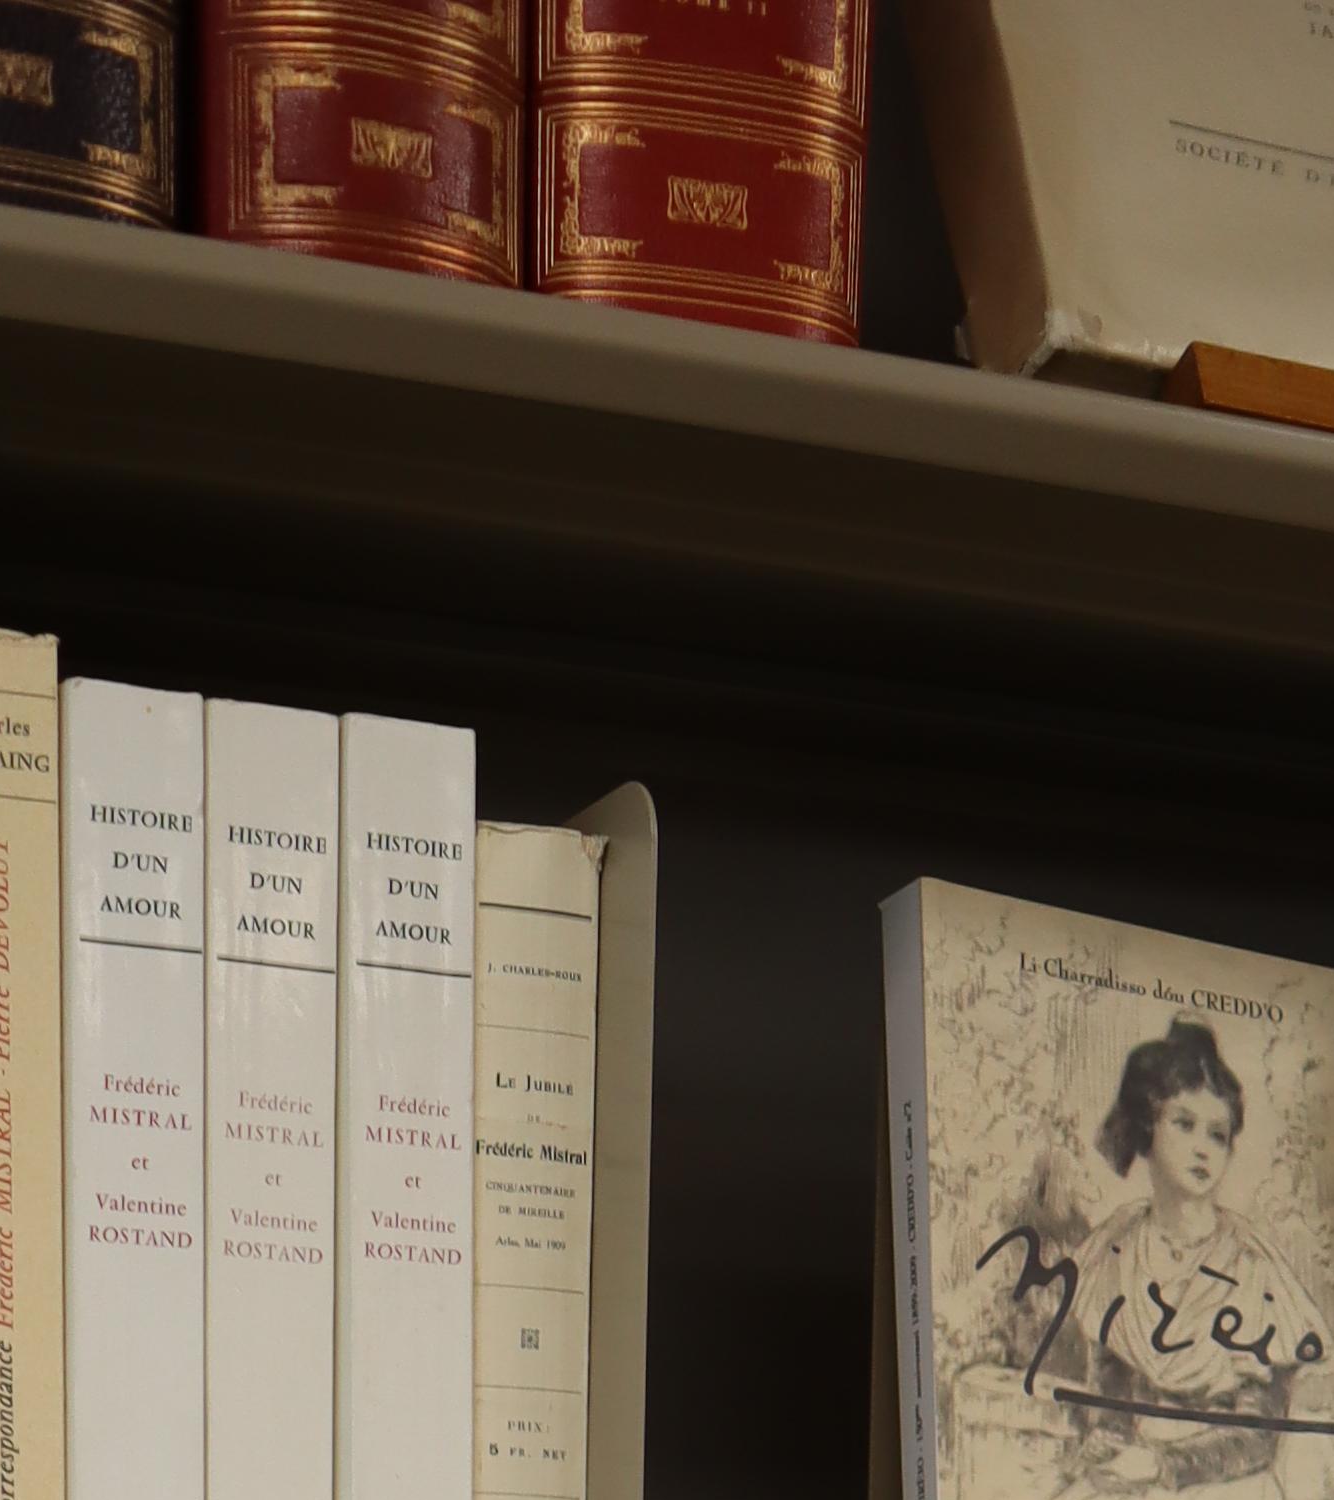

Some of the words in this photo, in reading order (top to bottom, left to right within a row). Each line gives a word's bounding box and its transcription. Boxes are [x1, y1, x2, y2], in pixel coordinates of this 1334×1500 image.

[90, 804, 193, 834] HISTOIRE
[112, 851, 169, 874] D'UN
[100, 896, 182, 920] AMOUR
[1020, 952, 1037, 973] Li
[1044, 958, 1146, 996] Charradisso
[1191, 989, 1284, 1024] CREDD'O
[103, 1073, 181, 1098] Frédéric
[89, 1105, 193, 1131] MISTRAL
[131, 1155, 150, 1171] et
[476, 1139, 533, 1159] Frédéric
[540, 1144, 587, 1166] Mistral
[95, 1193, 188, 1218] Valentine
[88, 1225, 194, 1249] ROSTAND
